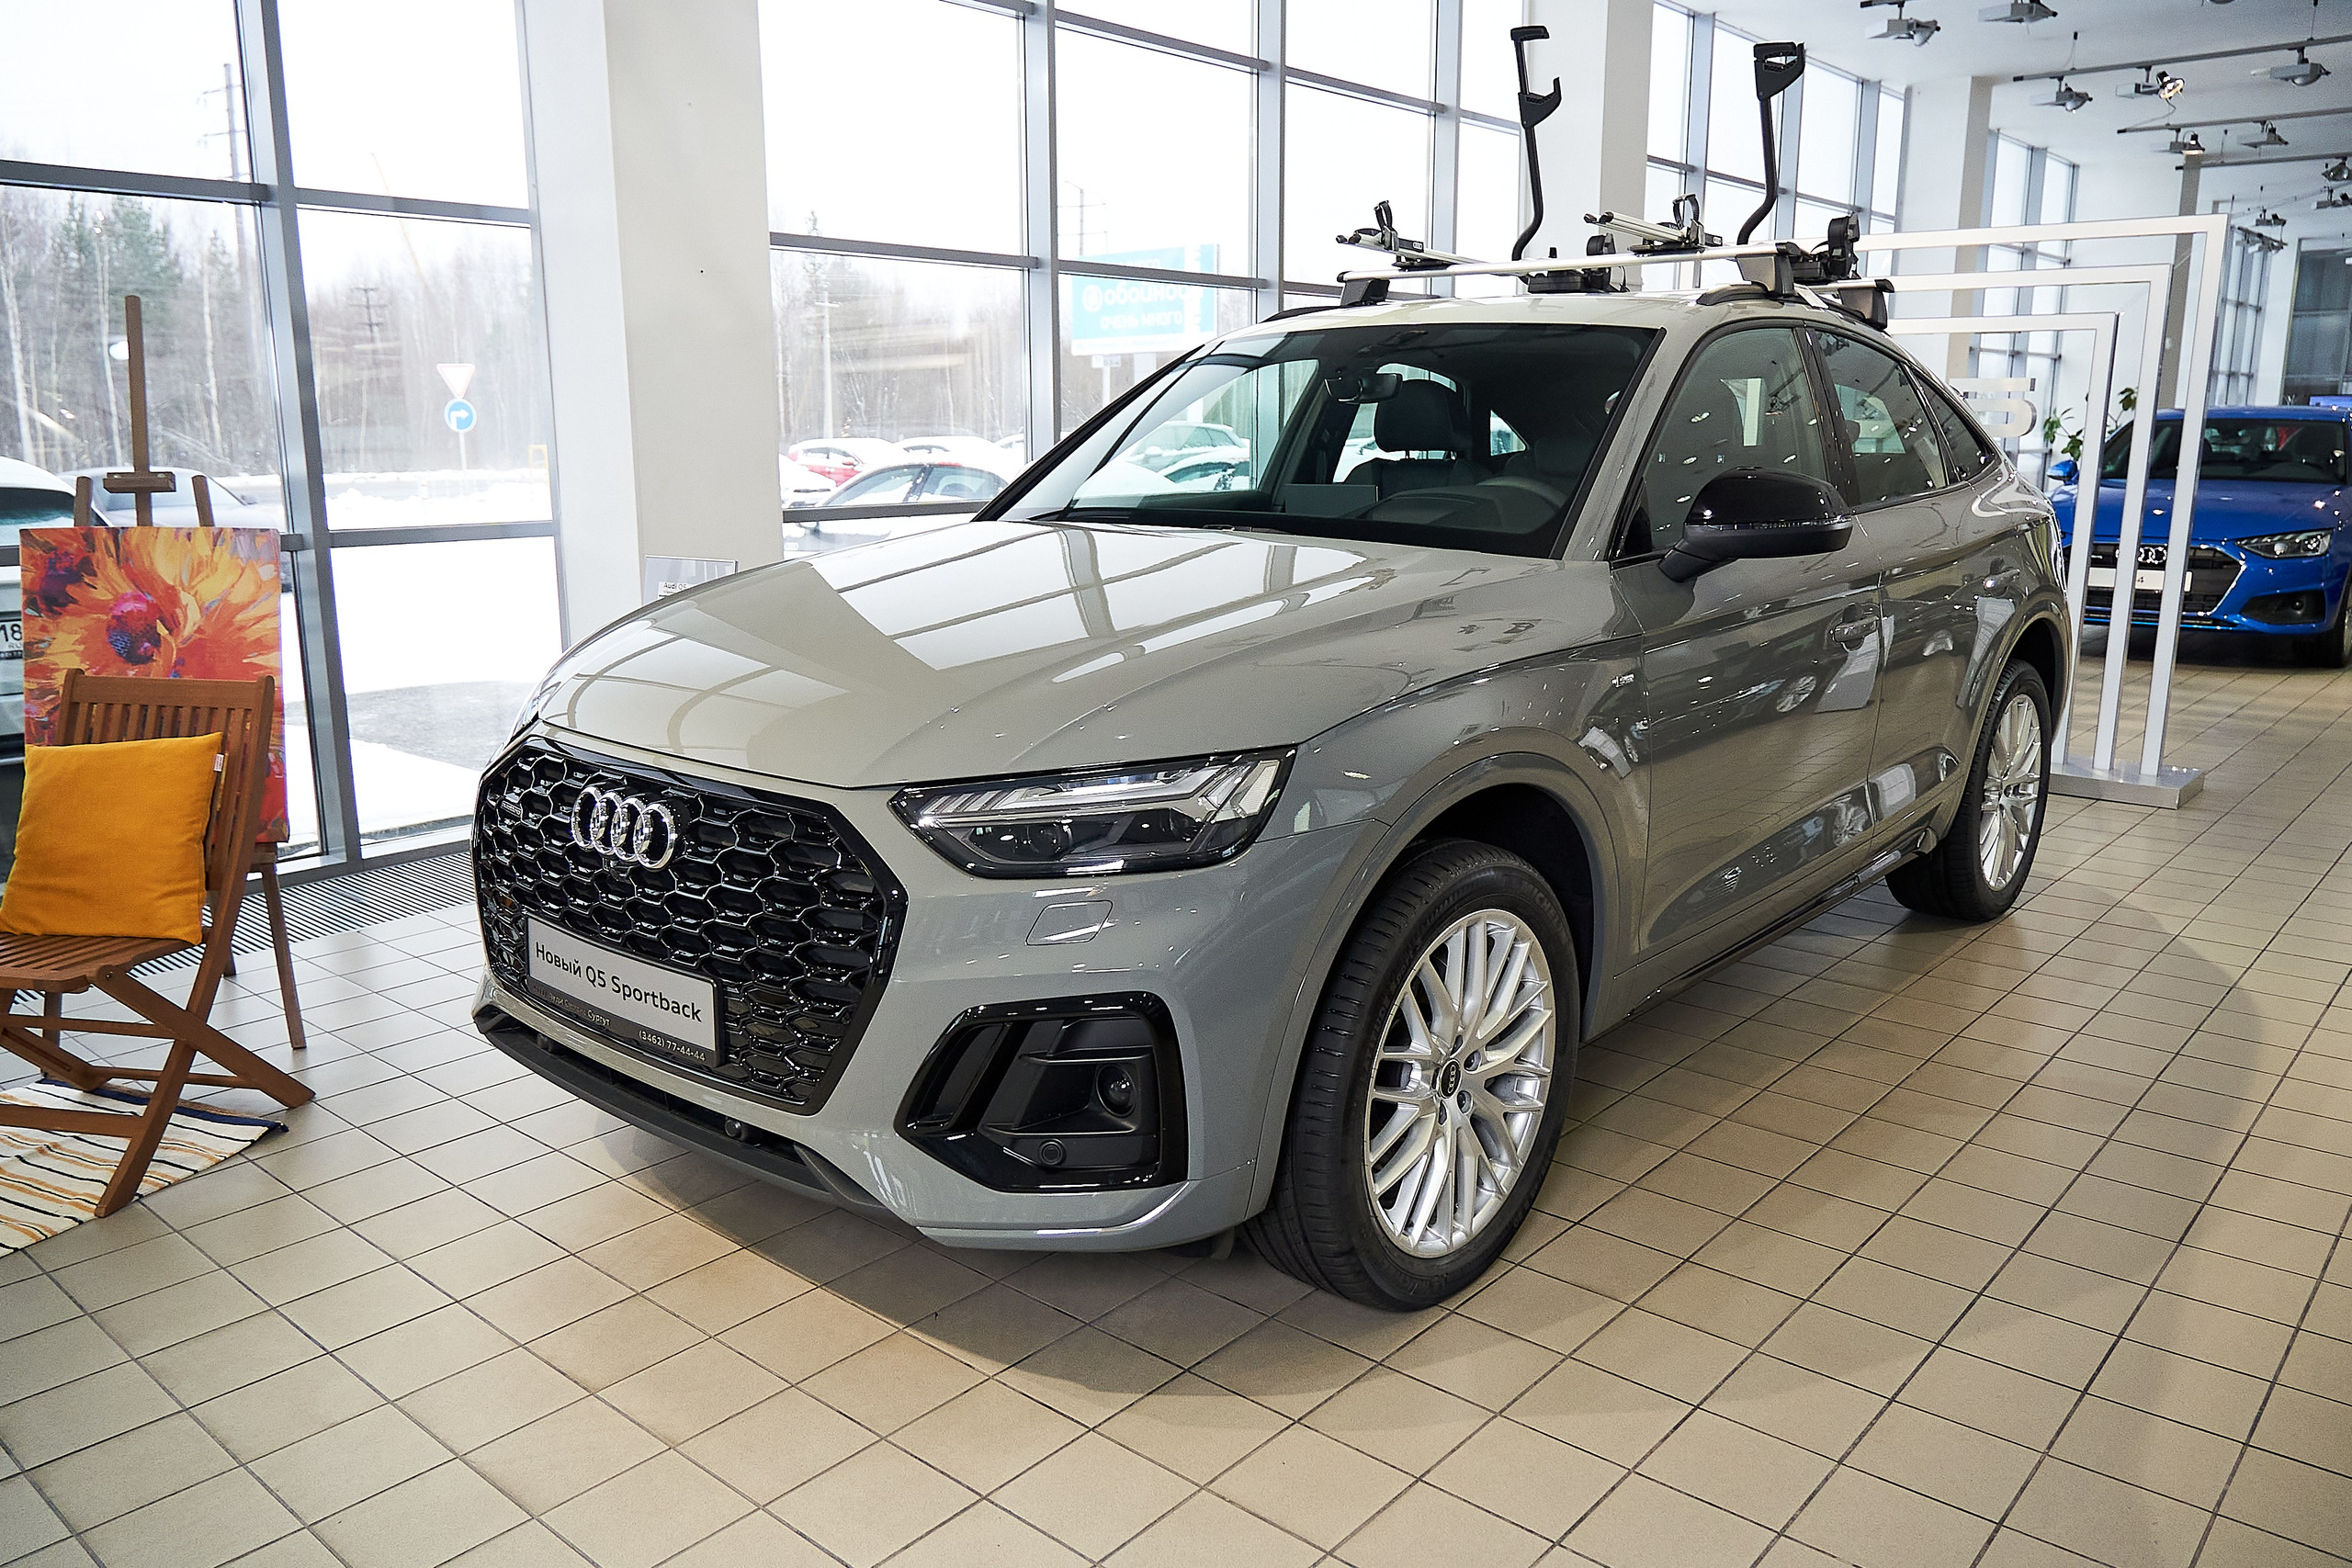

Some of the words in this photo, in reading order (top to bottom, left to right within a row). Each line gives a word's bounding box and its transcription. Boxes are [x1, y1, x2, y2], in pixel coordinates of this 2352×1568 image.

[536, 942, 582, 978] Новый
[585, 965, 606, 988] Q5
[611, 976, 702, 1022] Sportback
[587, 1010, 610, 1026] Сургут
[639, 1030, 665, 1047] (3462)
[666, 1040, 706, 1062] 77-44-44
